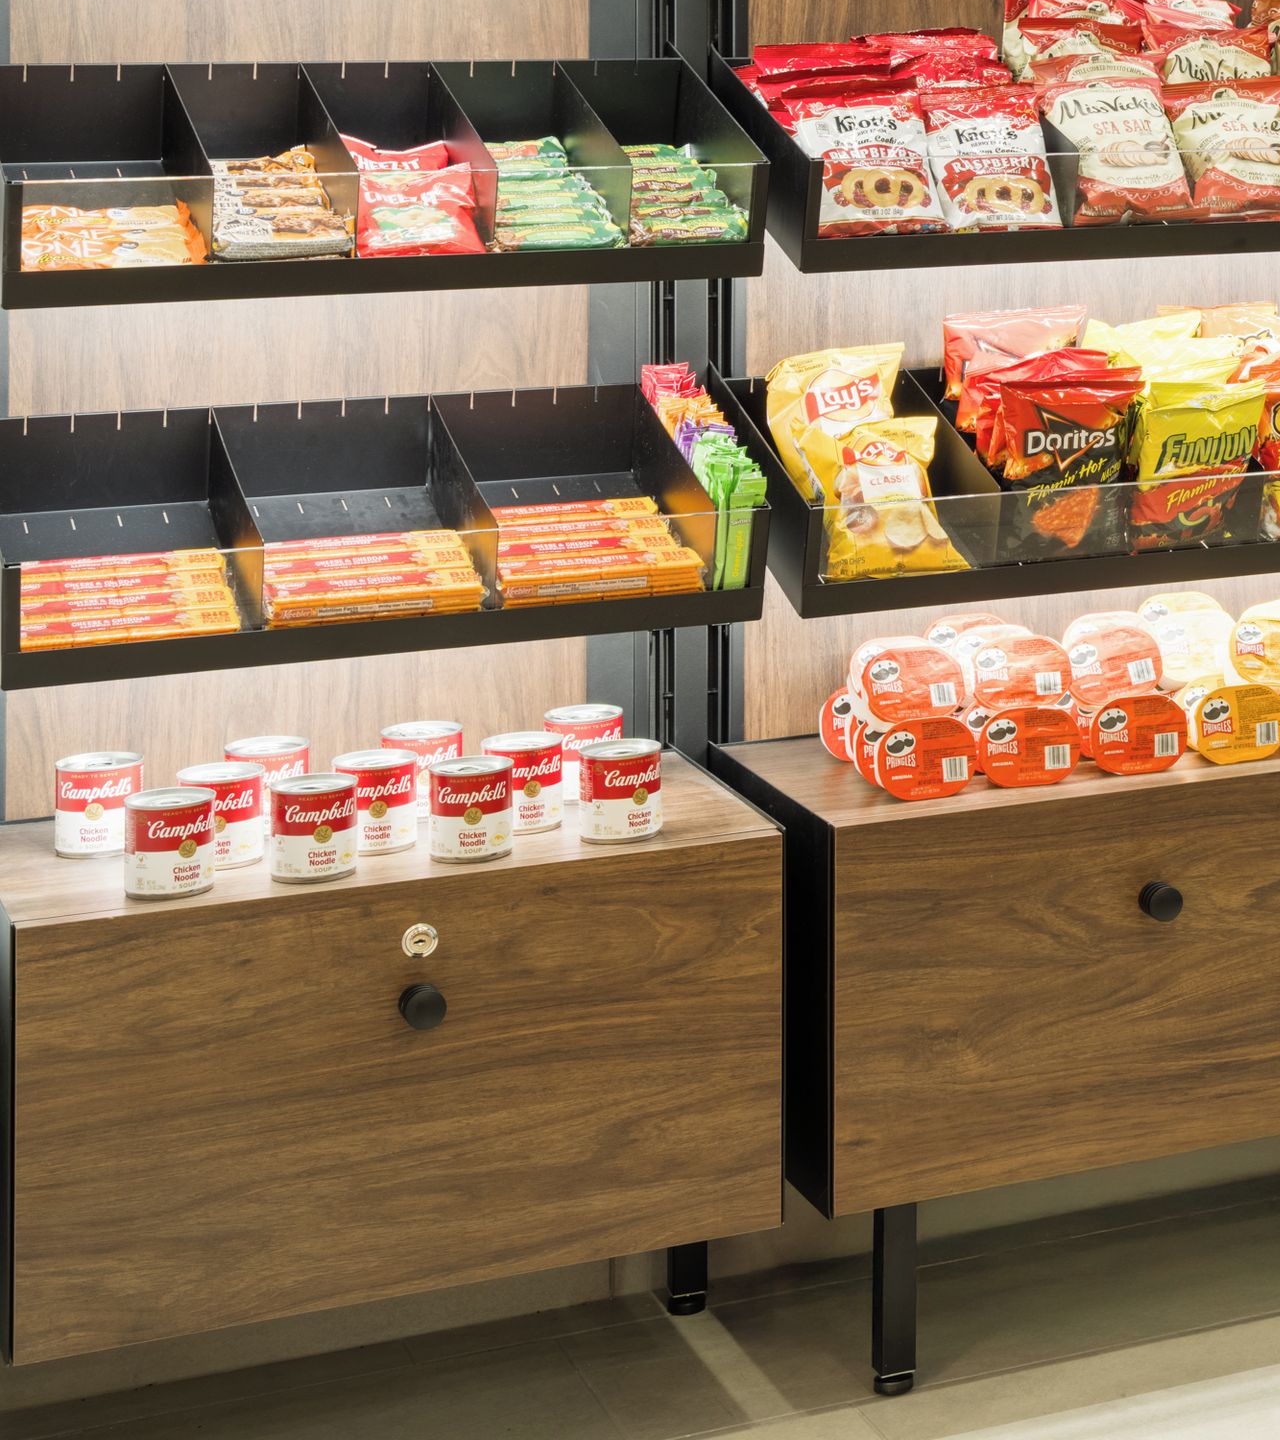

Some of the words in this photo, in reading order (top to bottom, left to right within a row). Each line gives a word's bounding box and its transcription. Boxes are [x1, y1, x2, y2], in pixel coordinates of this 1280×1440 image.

[1093, 120, 1120, 135] SEA
[1123, 118, 1152, 134] SALT
[951, 157, 1039, 173] RASPBERRY
[812, 377, 876, 416] Lay's
[1027, 425, 1116, 455] Doritos
[1158, 426, 1258, 474] FUNYUN
[1203, 719, 1232, 736] PRINGLES
[987, 741, 1018, 756] PRINGLES
[885, 754, 916, 769] PRINGLES
[60, 776, 132, 804] Campbell's
[438, 780, 507, 808] Campbell's
[284, 796, 355, 826] Campbell's
[79, 826, 109, 836] Chicken
[80, 834, 108, 844] Noodle
[458, 830, 487, 841] Chicken
[459, 838, 486, 848] Noodle
[307, 848, 337, 860] Chicken
[308, 856, 336, 867] Noodle
